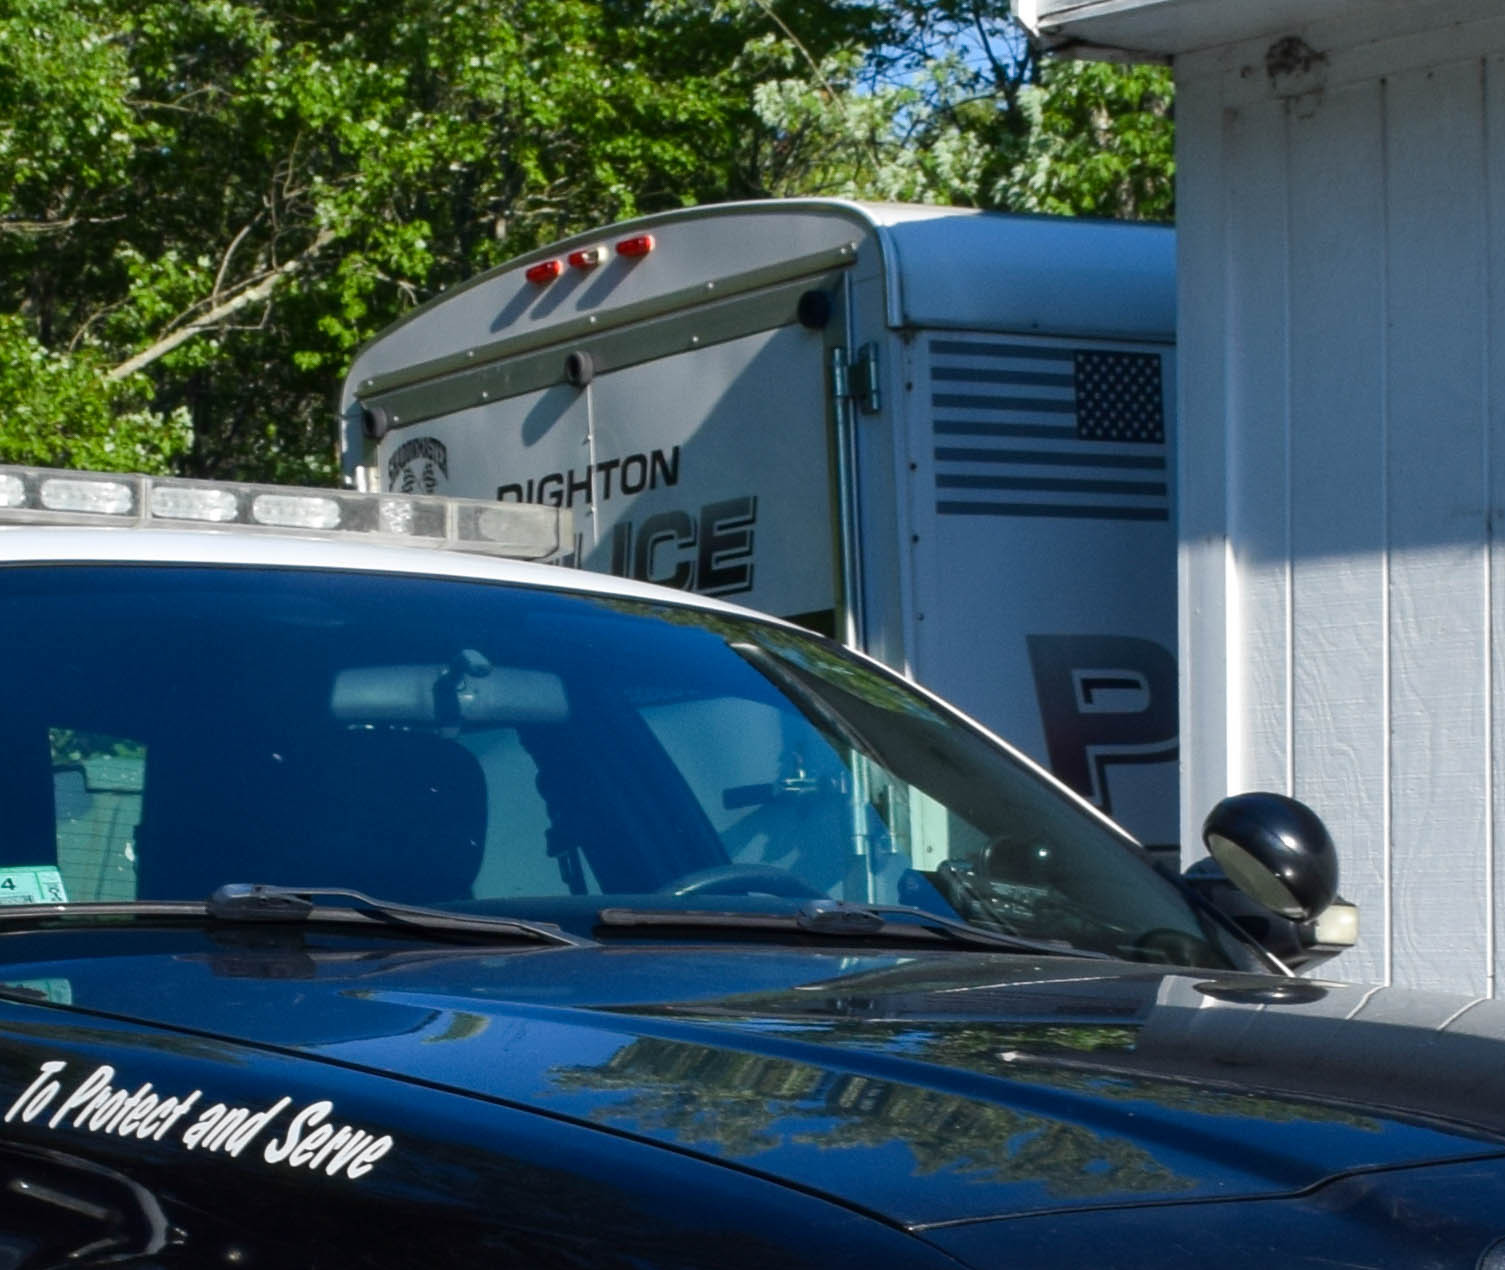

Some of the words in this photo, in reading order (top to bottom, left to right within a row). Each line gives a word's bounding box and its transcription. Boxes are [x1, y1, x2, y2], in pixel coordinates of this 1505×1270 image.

[0, 877, 17, 891] 4
[4, 1061, 67, 1122] To
[49, 1065, 203, 1141] Protect
[182, 1096, 292, 1157] and
[264, 1101, 394, 1179] Serve
